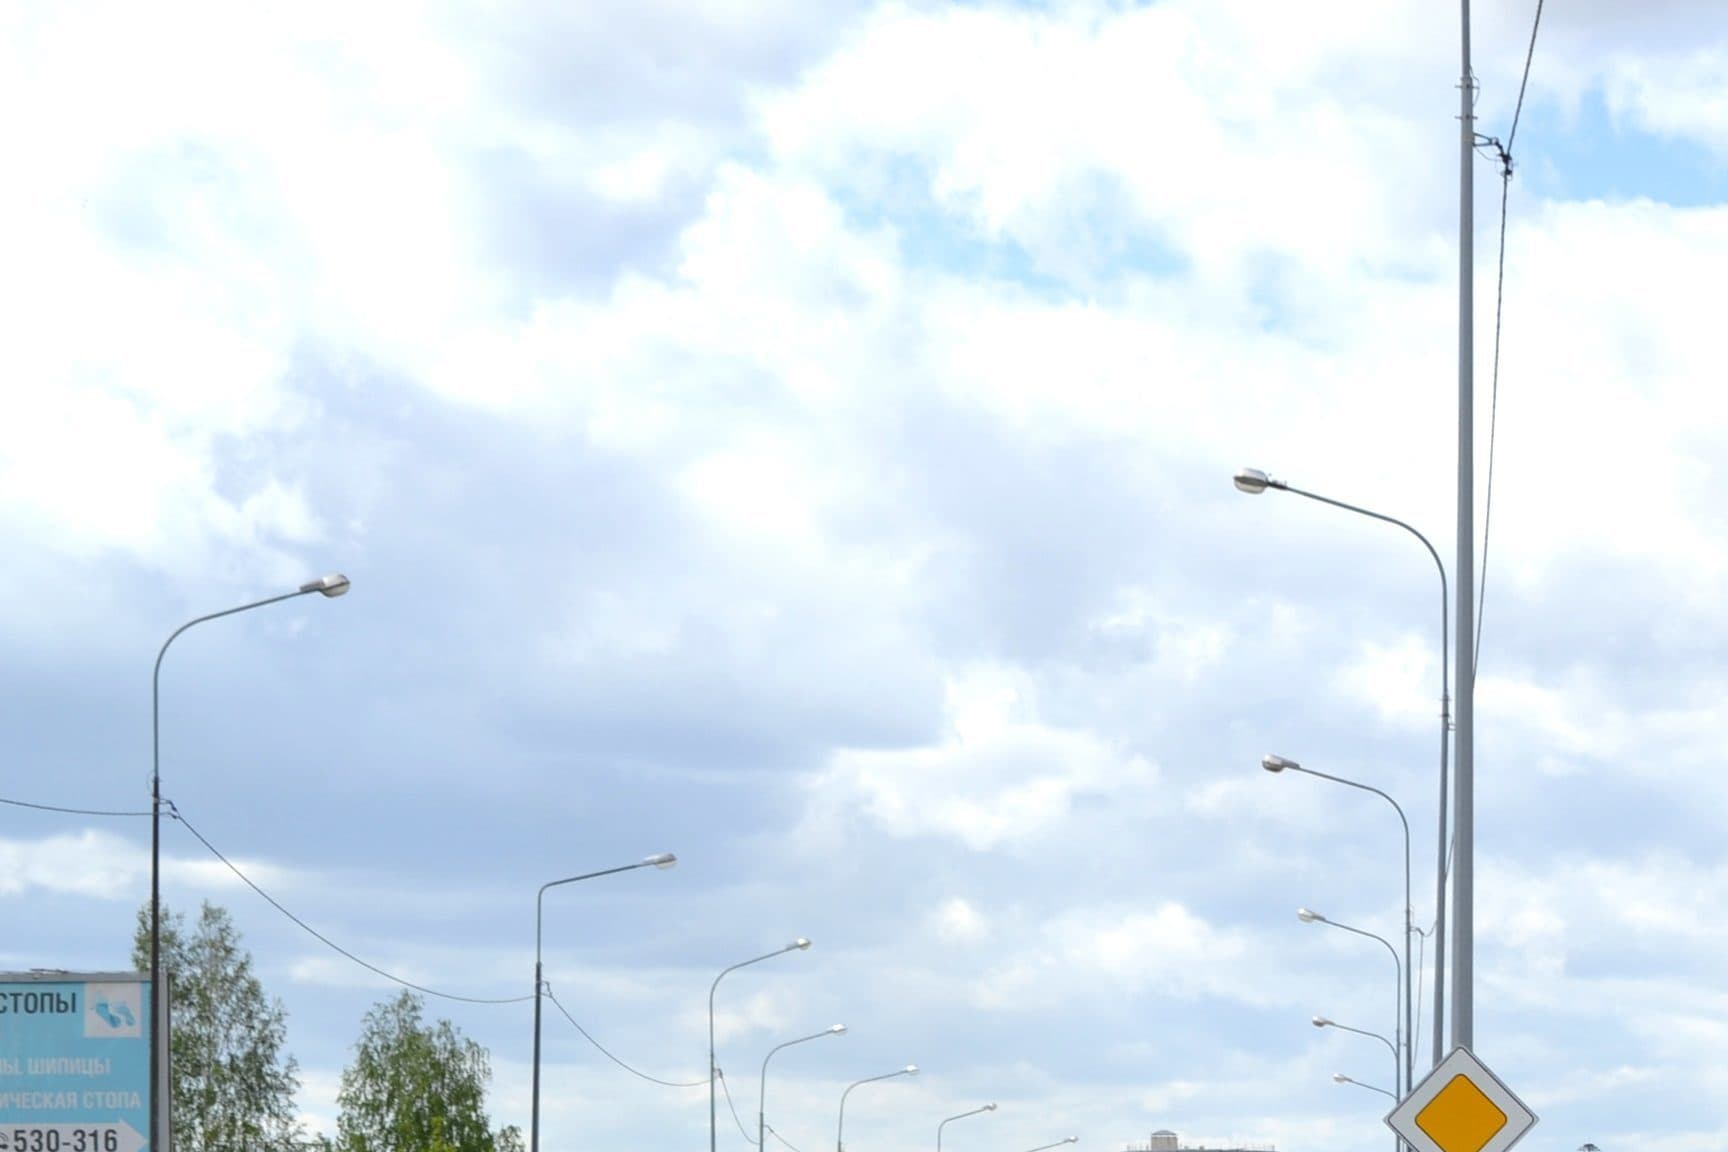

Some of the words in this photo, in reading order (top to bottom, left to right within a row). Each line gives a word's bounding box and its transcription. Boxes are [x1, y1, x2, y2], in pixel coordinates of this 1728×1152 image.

[0, 992, 77, 1014] СТОПЫ
[28, 1057, 111, 1078] ШИПИЦЫ
[82, 1091, 142, 1110] СТОПА
[14, 1129, 118, 1152] 530-316
